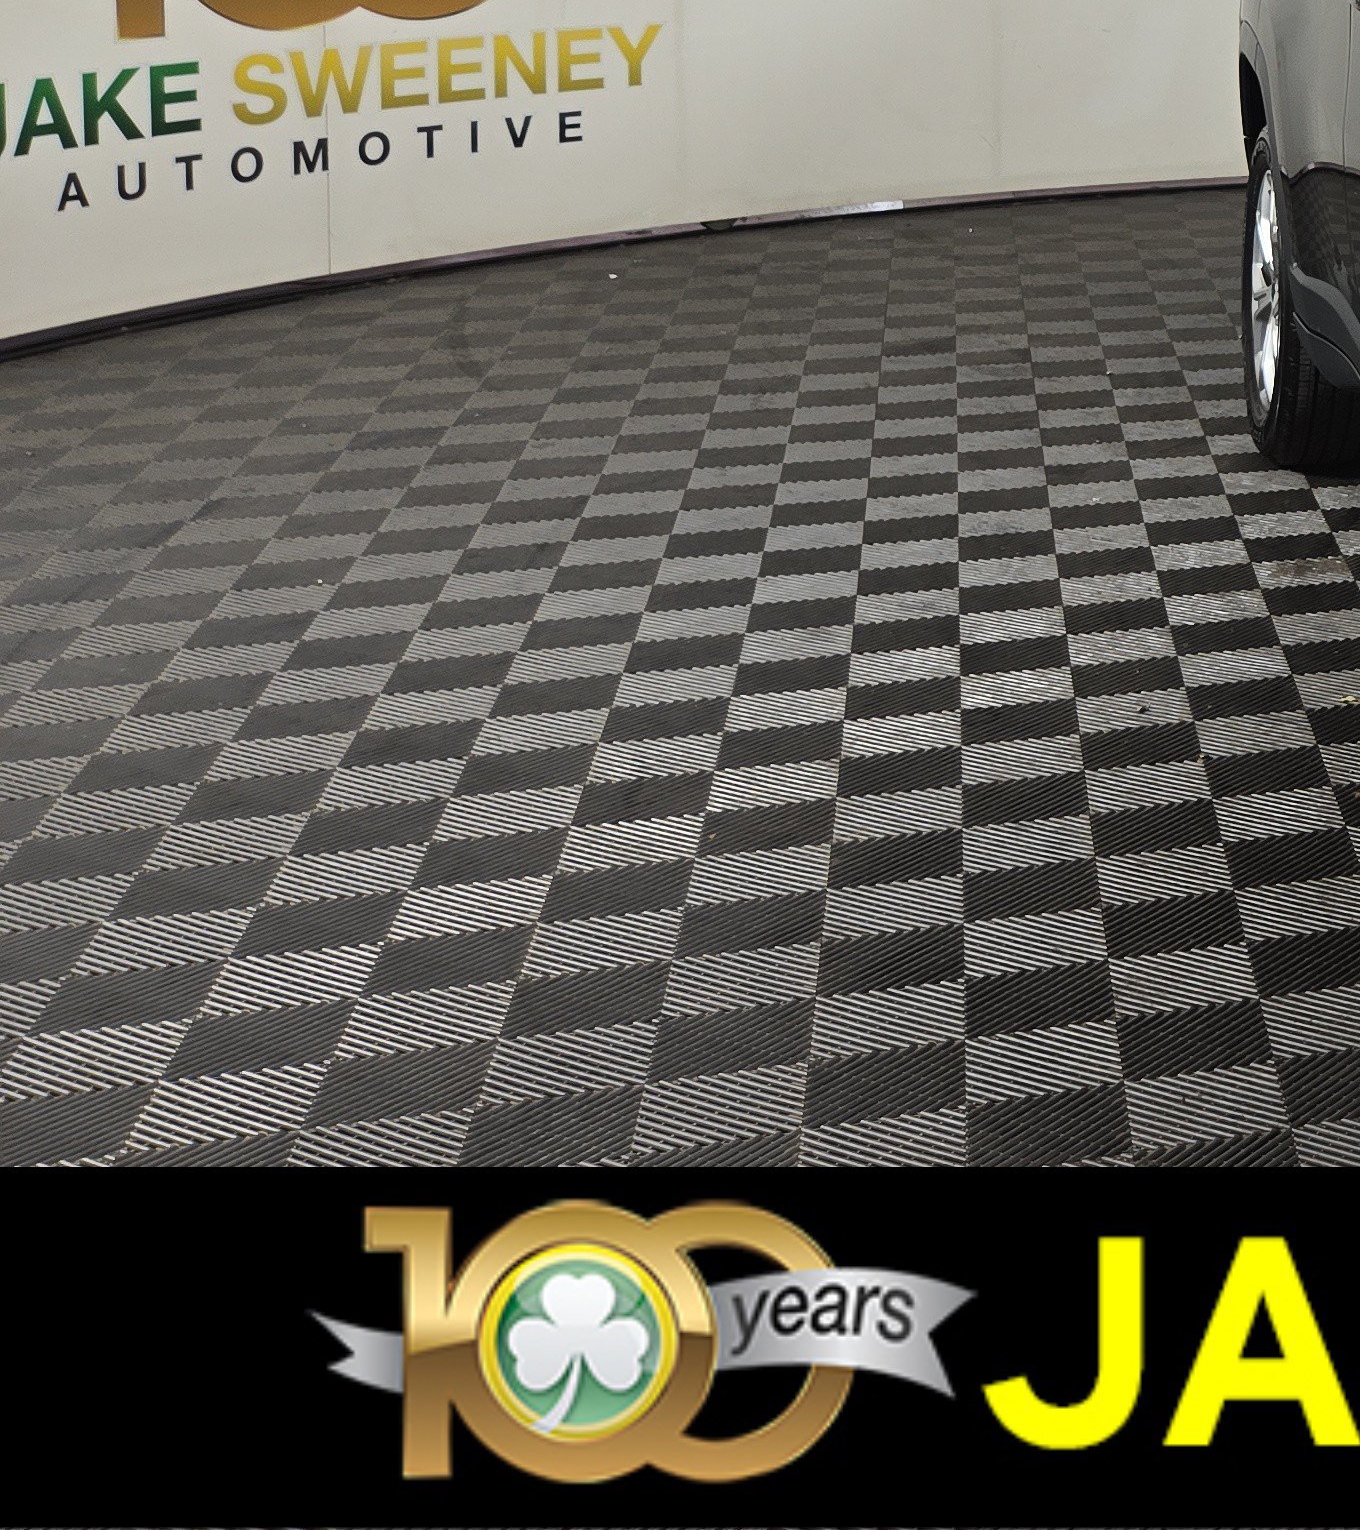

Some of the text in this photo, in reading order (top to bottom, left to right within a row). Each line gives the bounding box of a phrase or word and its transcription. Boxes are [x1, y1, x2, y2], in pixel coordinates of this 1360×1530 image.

[0, 23, 663, 157] AKE SWEENEY
[57, 110, 584, 212] AUTOMOTIVE
